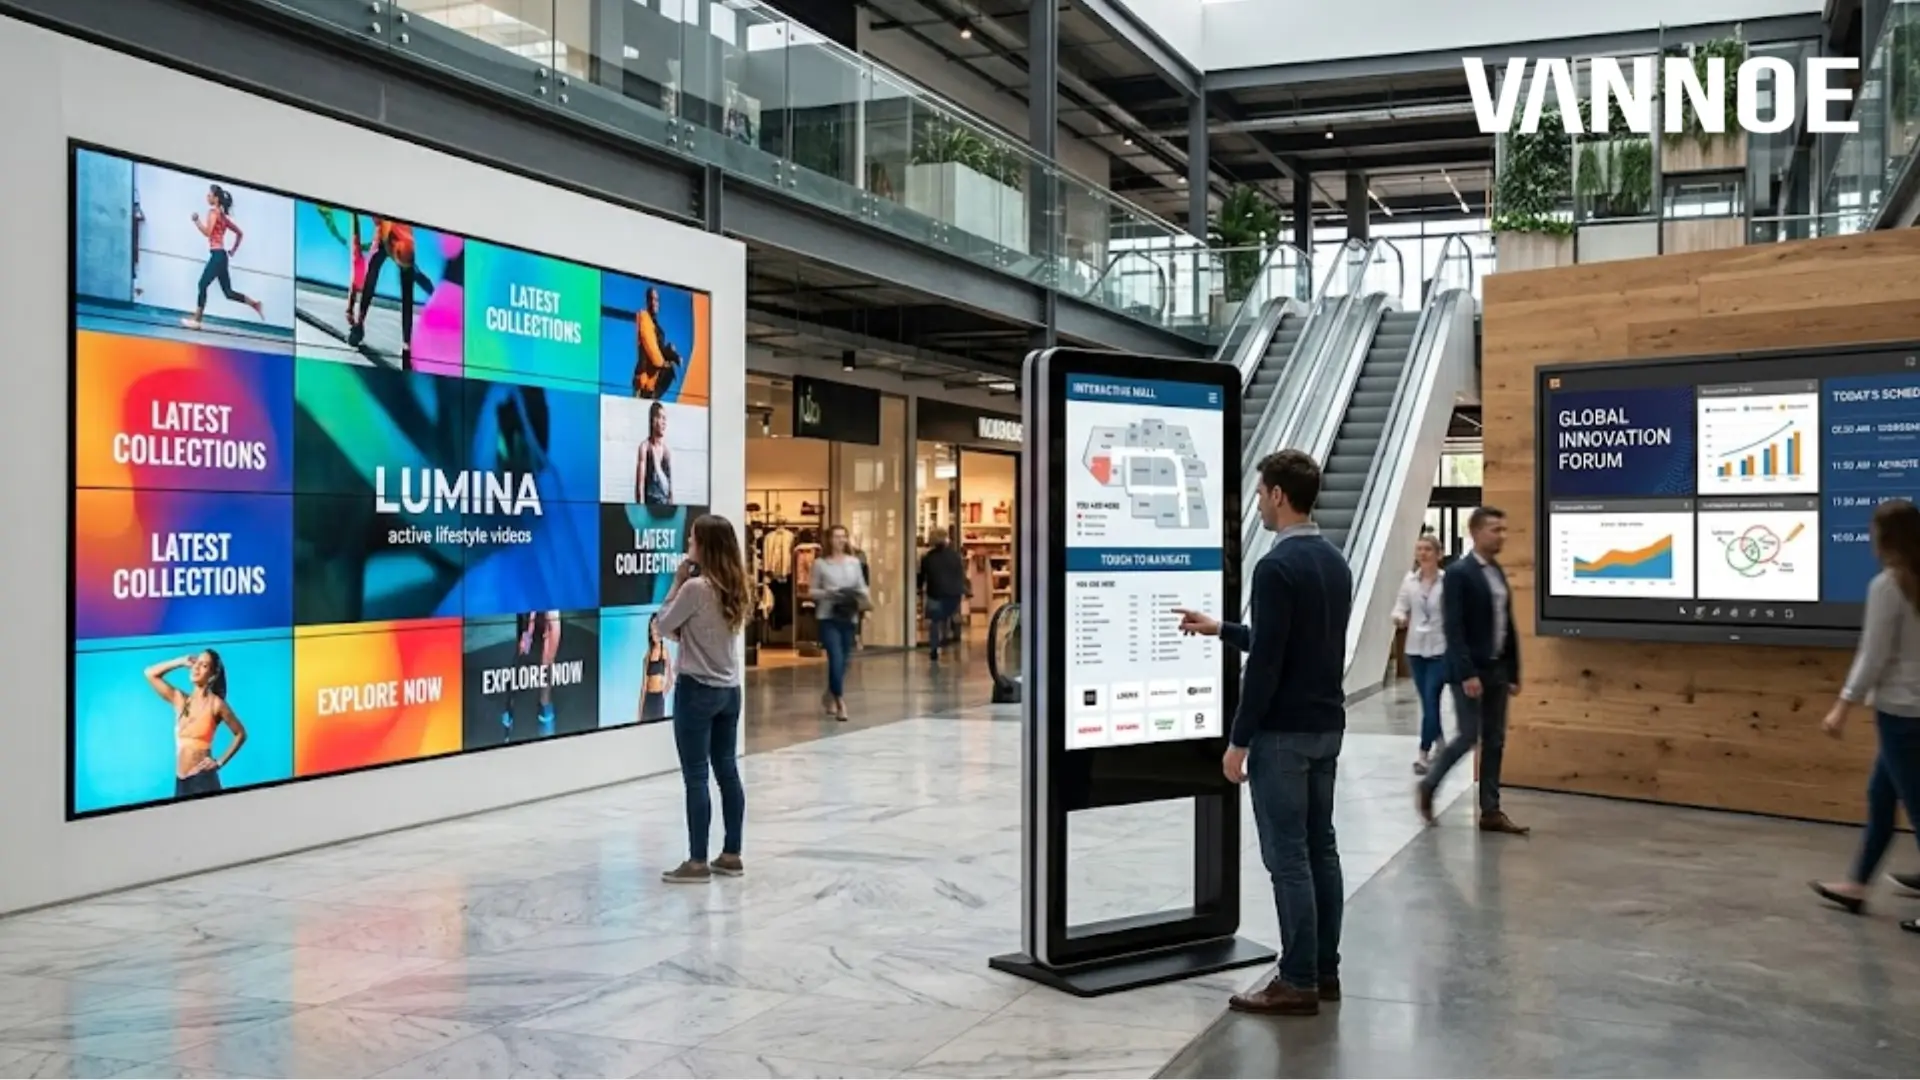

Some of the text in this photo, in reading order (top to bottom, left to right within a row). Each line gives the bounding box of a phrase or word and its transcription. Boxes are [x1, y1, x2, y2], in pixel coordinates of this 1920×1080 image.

[510, 282, 561, 315] LATEST
[486, 305, 582, 344] COLLECTIONS
[151, 400, 232, 434] LATEST
[1559, 407, 1630, 427] GLOBAL
[113, 432, 267, 470] COLLECTIONS
[1559, 427, 1671, 449] INNOVATION
[1559, 452, 1623, 470] FORUM
[375, 465, 543, 515] LUMINA
[151, 532, 232, 562] LATEST
[388, 525, 533, 548] active lifestyle videos
[634, 528, 677, 550] LATEST
[113, 565, 266, 600] COLLECTIONS
[482, 660, 584, 694] EXPLORE NOW
[317, 676, 443, 716] EXPLORE NOW
